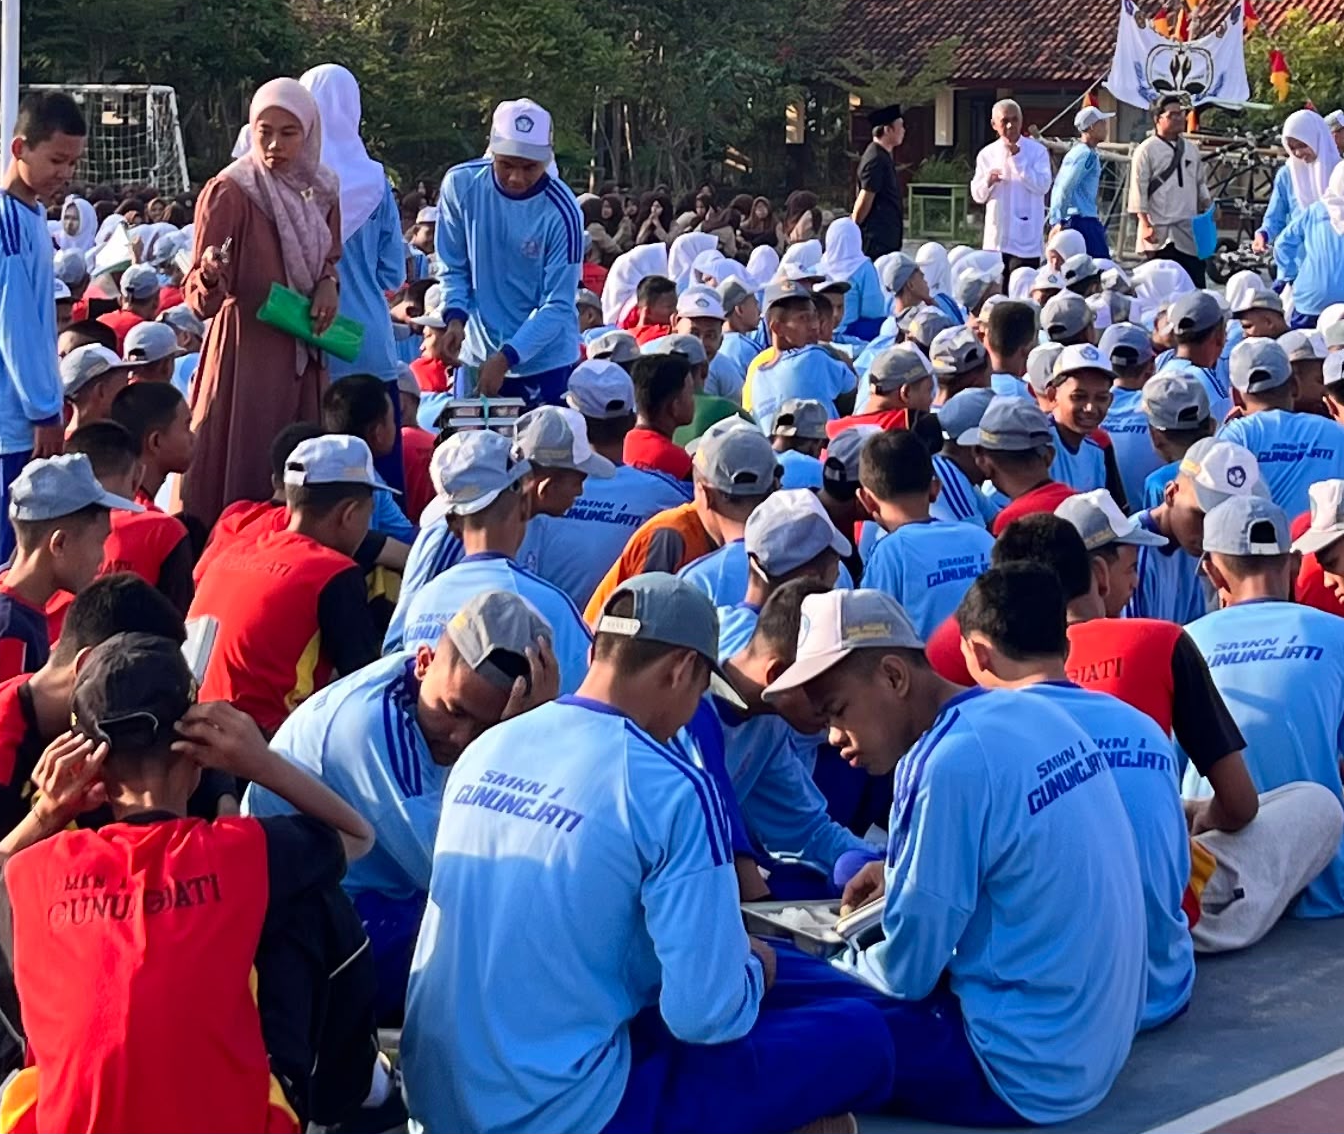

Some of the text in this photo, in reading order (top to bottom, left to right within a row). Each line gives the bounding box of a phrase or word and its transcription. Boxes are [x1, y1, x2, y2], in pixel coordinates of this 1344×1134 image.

[1207, 645, 1325, 668] UNUNGJATI
[1213, 637, 1281, 652] SMKN
[1035, 745, 1077, 781] SMKN
[479, 769, 548, 796] SMKN
[452, 783, 585, 834] GUNUNGJATI
[47, 873, 223, 927] GUNUGJATI
